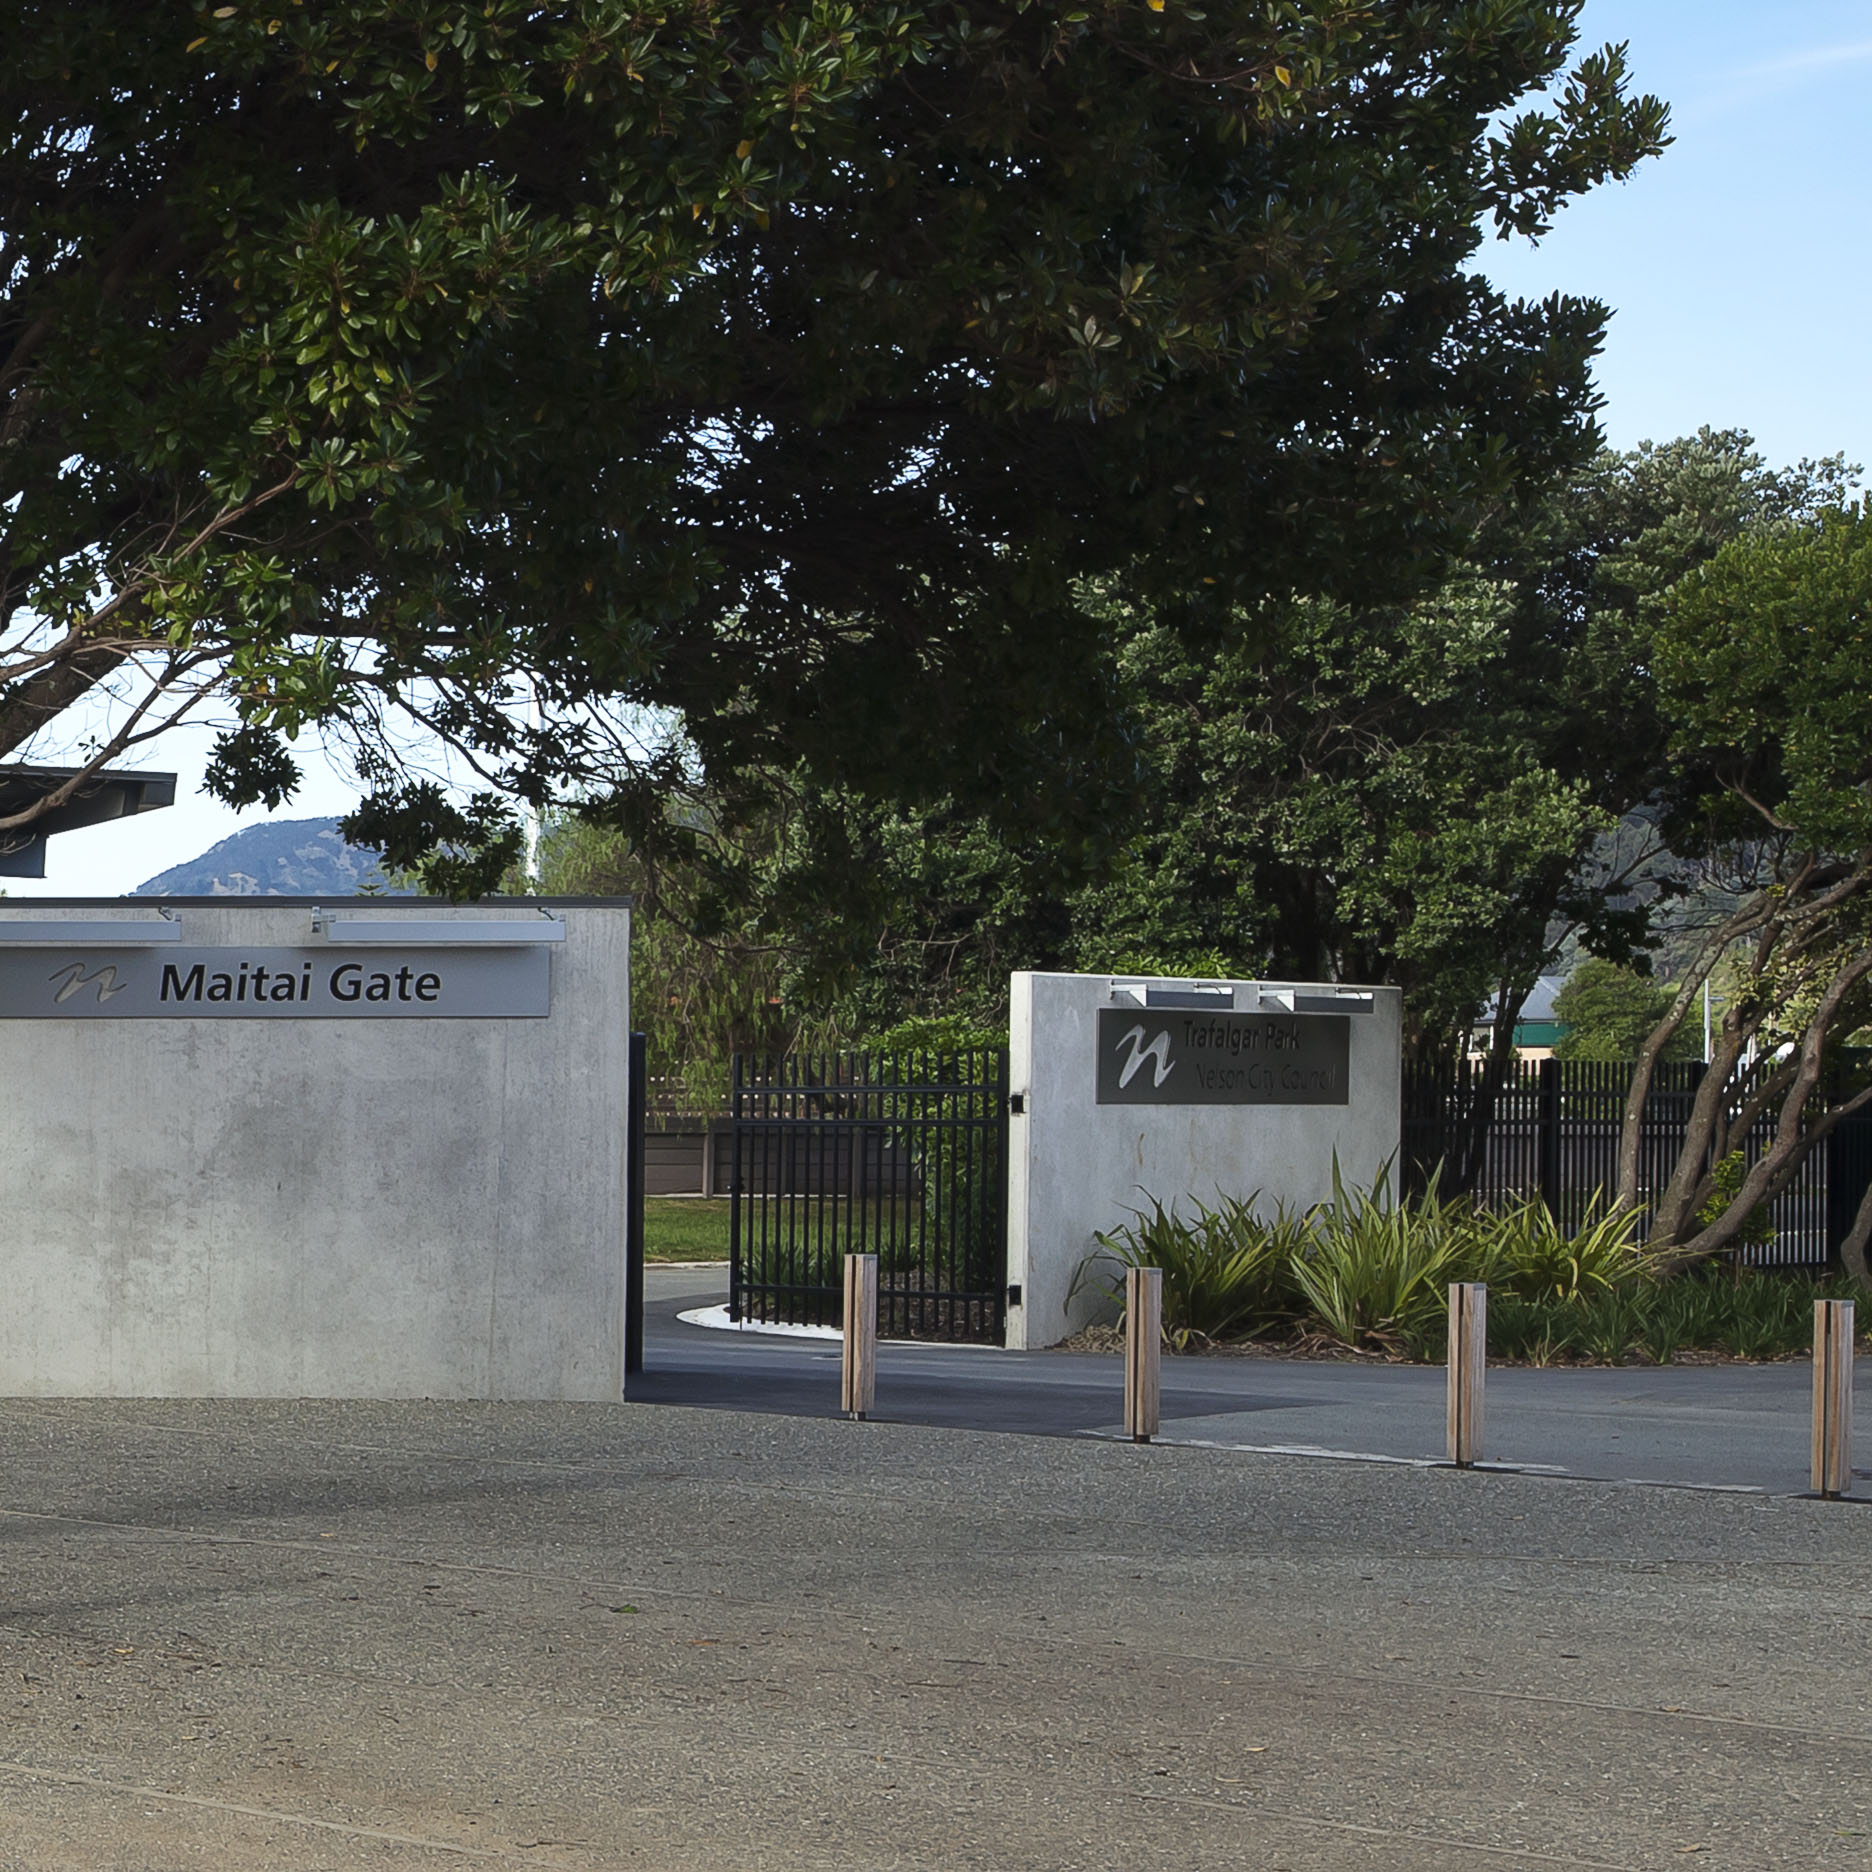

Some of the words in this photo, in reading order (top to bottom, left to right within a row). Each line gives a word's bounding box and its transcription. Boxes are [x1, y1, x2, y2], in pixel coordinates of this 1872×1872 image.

[159, 962, 312, 1002] Maitai
[328, 963, 442, 1002] Gate
[1183, 1018, 1259, 1056] Trafalgar
[1265, 1021, 1300, 1050] Park
[1196, 1063, 1245, 1089] Nelson
[1281, 1063, 1336, 1089] Council
